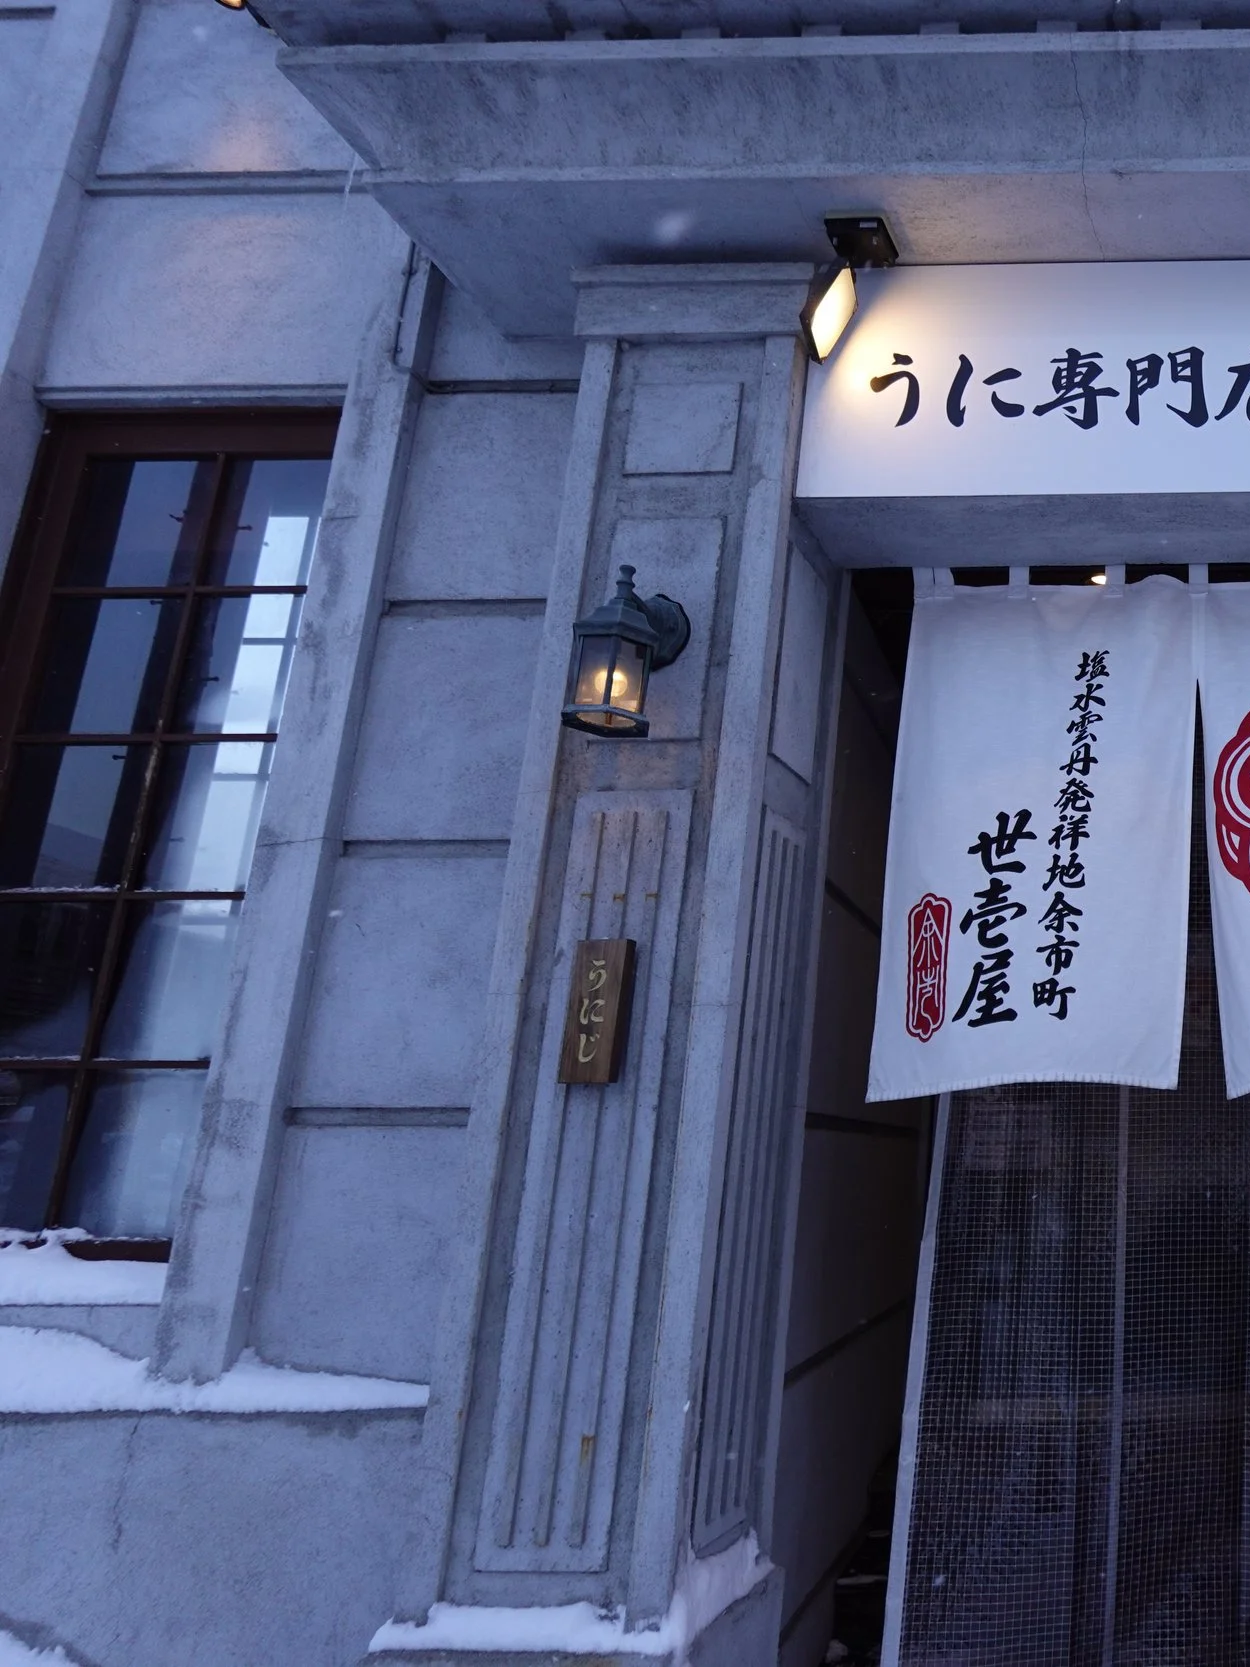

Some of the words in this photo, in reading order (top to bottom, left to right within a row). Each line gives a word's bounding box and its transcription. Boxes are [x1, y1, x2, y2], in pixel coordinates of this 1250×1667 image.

[952, 808, 1037, 1028] 世壱屋
[1032, 650, 1110, 1021] 塩水雲丹発祥地余市町
[578, 959, 608, 1063] うにじ
